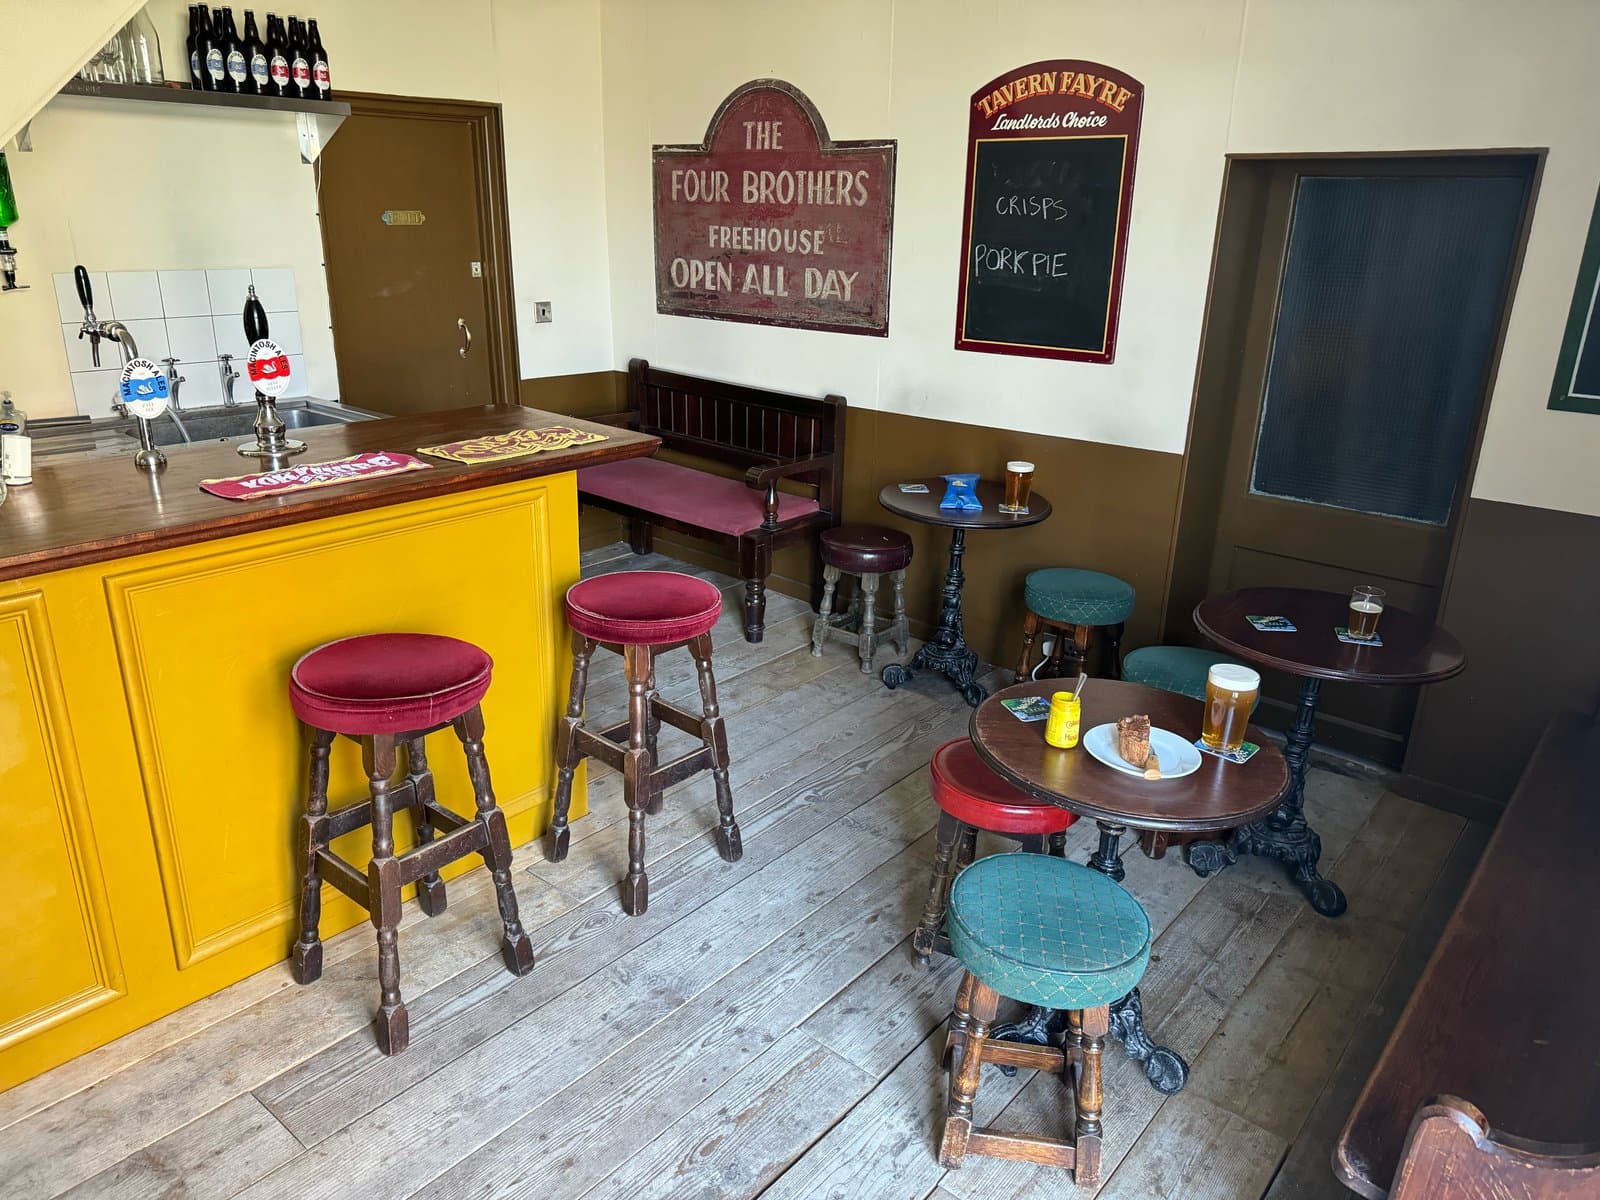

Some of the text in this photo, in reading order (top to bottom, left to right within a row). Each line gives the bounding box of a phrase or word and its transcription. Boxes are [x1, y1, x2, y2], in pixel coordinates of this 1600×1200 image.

[977, 71, 1132, 119] TAVERN FAYRE
[743, 121, 784, 151] THE
[991, 110, 1108, 131] Landlords Choice
[671, 168, 870, 207] FOUR BROTHERS
[996, 196, 1068, 220] CRISPS
[709, 225, 824, 255] FREEHOUSE
[670, 257, 860, 301] OPEN ALL DAY
[248, 340, 289, 376] MACINTOSH ALES
[121, 359, 168, 397] MACINTOSH ALES
